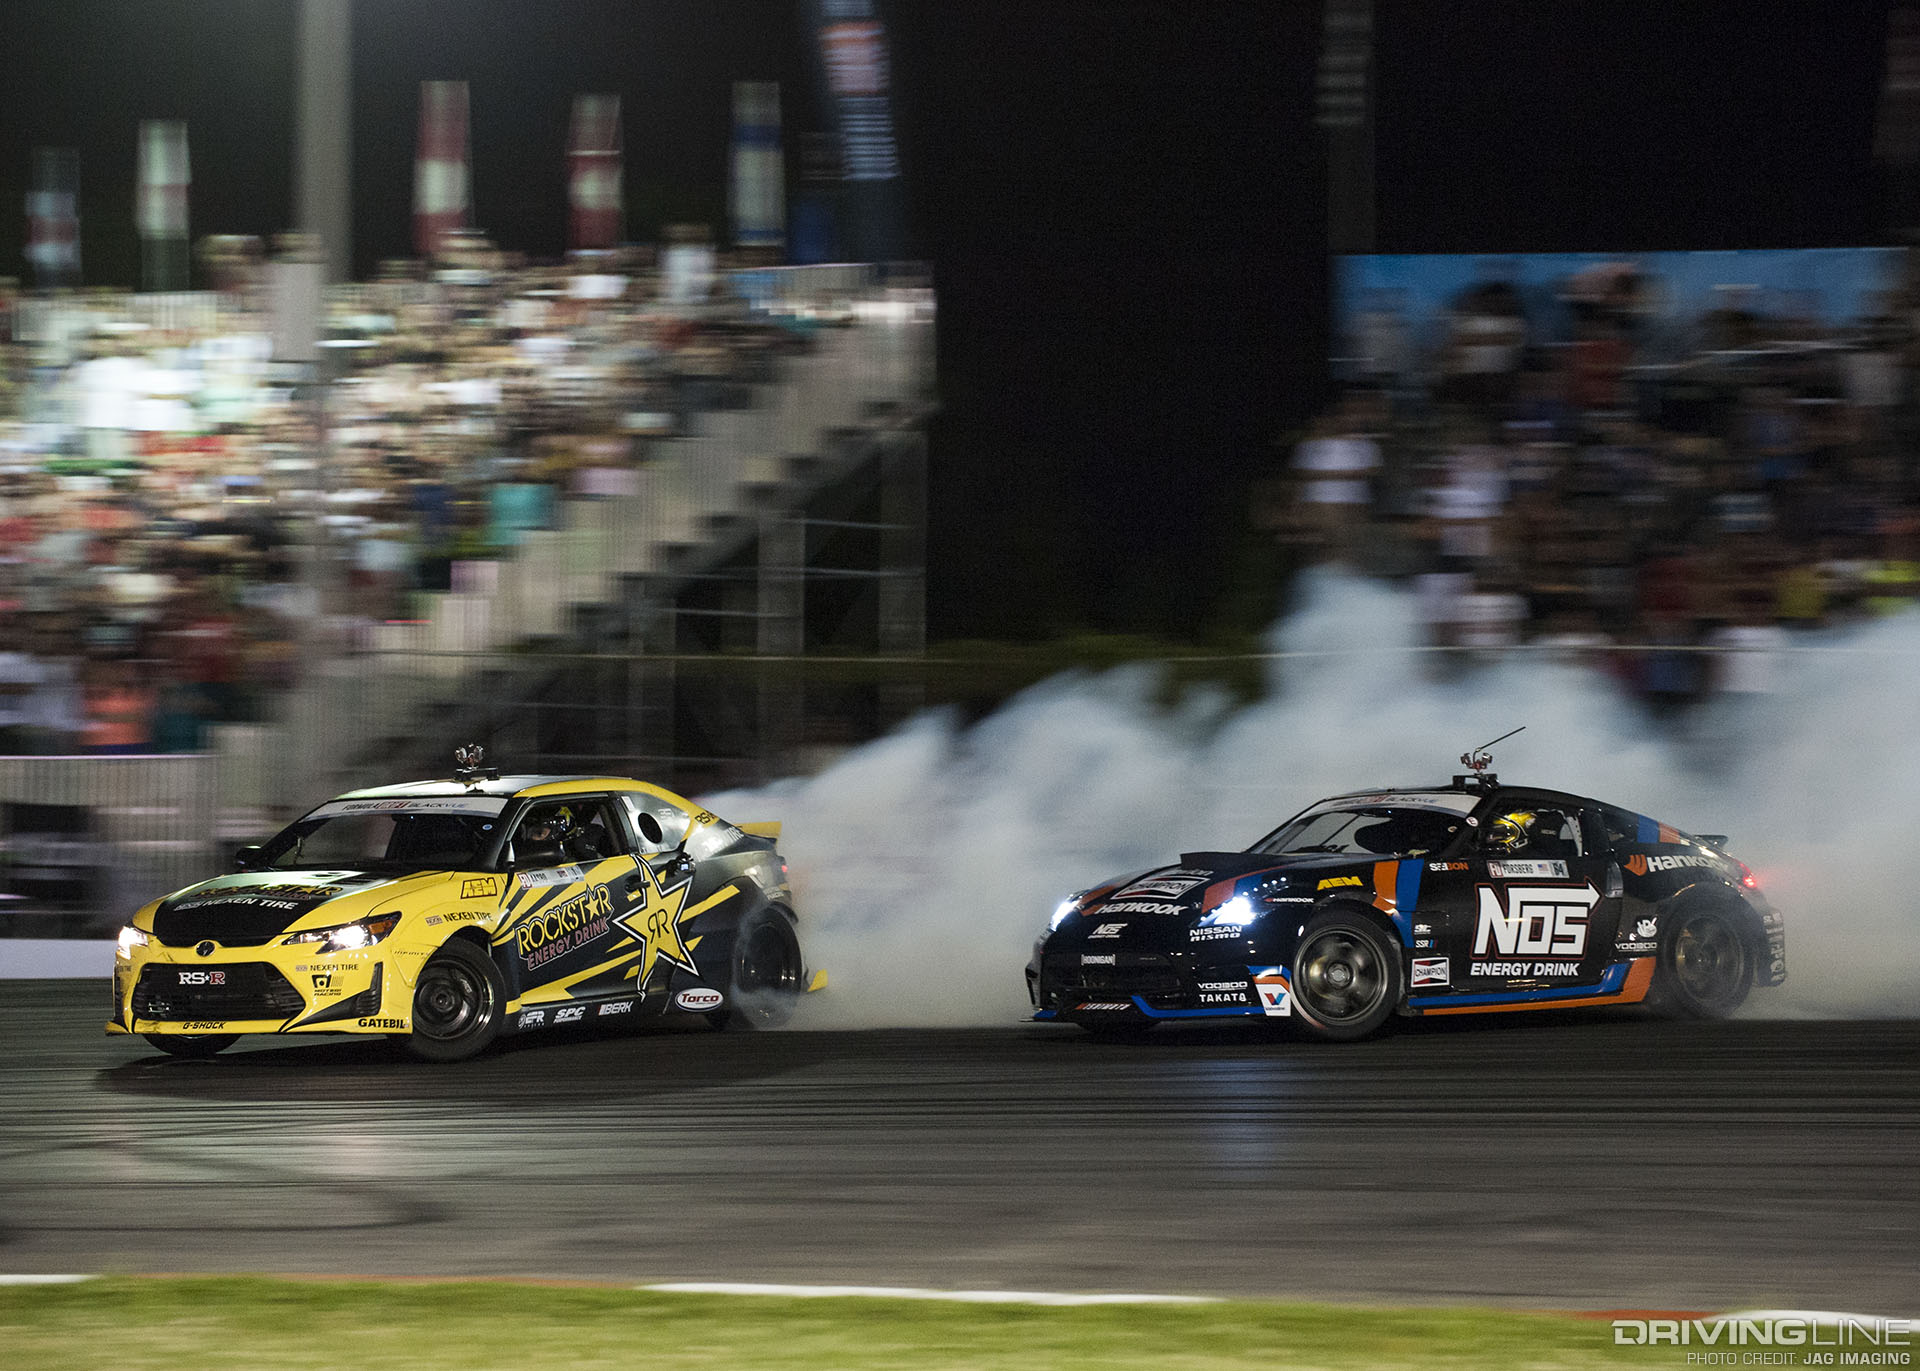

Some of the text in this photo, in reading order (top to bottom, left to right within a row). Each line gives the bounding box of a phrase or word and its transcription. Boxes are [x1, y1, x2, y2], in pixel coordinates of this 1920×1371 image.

[1429, 862, 1469, 871] SEIBON
[460, 876, 497, 899] AEM
[1317, 876, 1363, 890] AEM
[201, 898, 258, 907] NEXEN
[260, 899, 299, 910] TIRE
[443, 911, 475, 922] NEXEN
[475, 911, 493, 922] TIRE
[1473, 882, 1600, 955] NOS
[1189, 925, 1243, 936] NISSAN
[528, 917, 609, 969] ENERGY DRINK
[341, 963, 359, 971] TIRE
[1415, 966, 1447, 978] CHAMPION
[1470, 962, 1580, 976] ENERGY DRINK
[682, 993, 719, 1003] Torco
[1199, 993, 1247, 1003] TAKATA
[555, 1006, 586, 1018] SPC
[605, 1001, 634, 1014] BERK
[183, 1021, 225, 1030] G-SHOCK
[358, 1018, 406, 1029] GATEBIL
